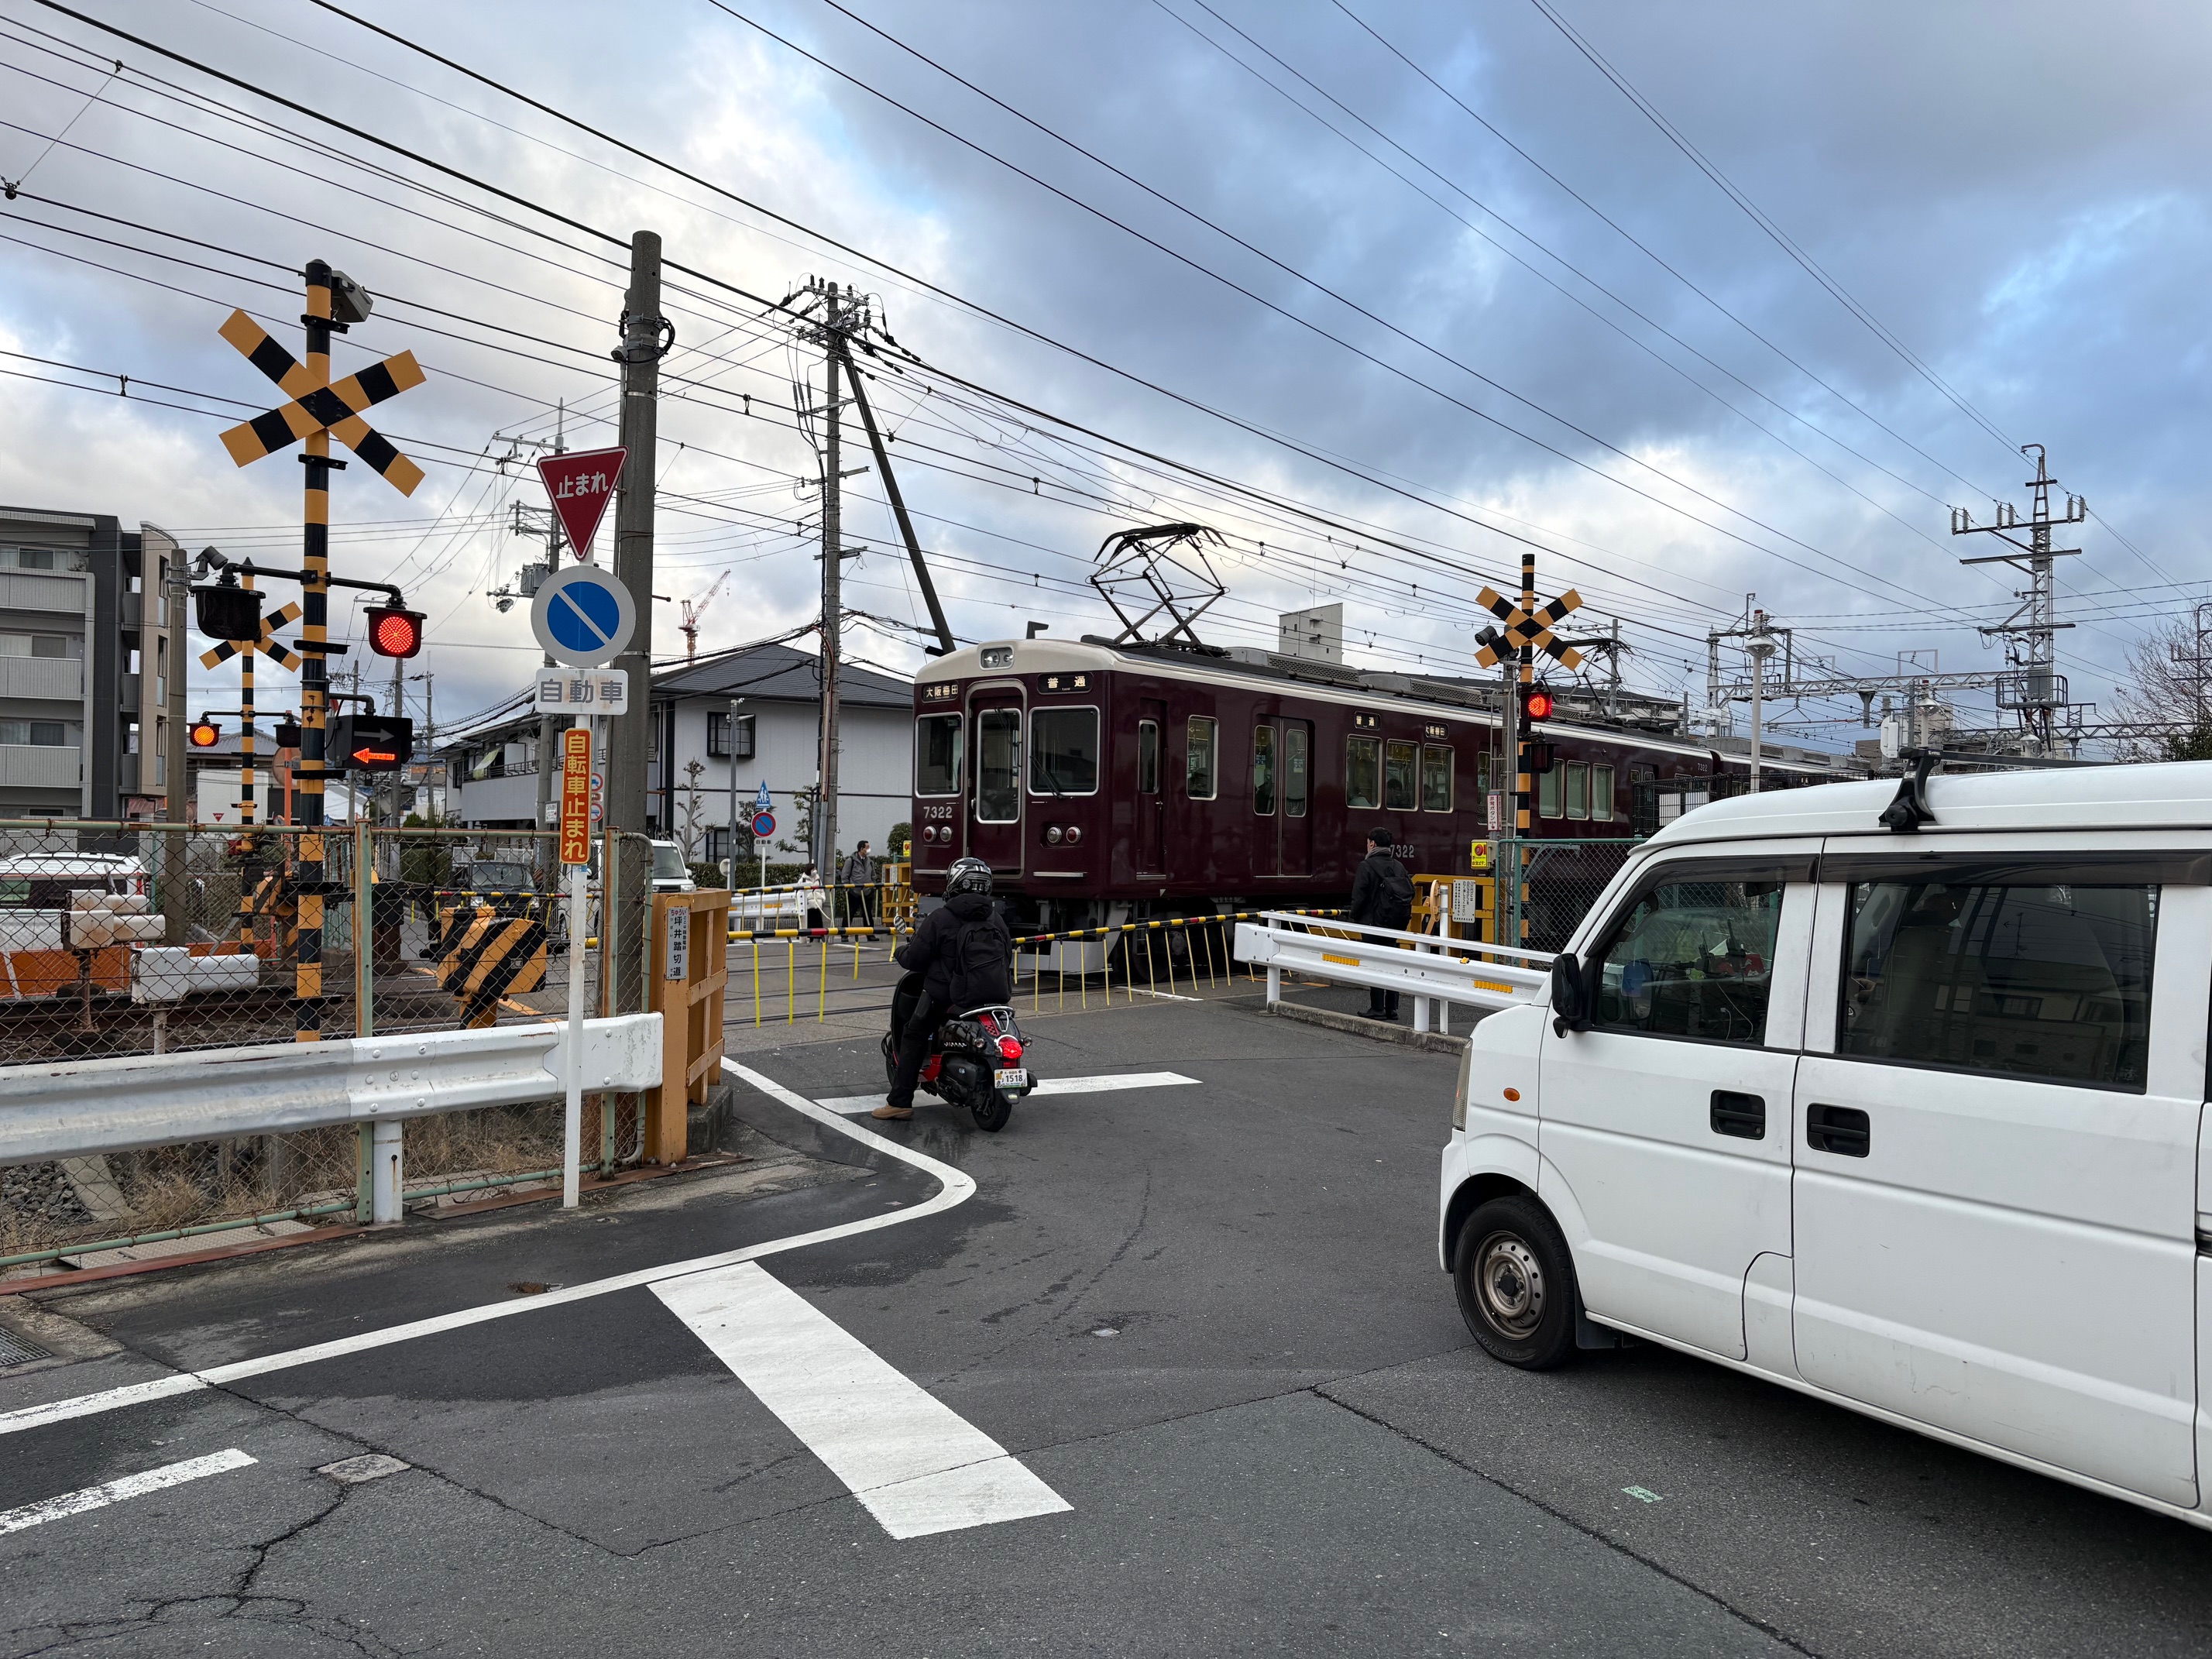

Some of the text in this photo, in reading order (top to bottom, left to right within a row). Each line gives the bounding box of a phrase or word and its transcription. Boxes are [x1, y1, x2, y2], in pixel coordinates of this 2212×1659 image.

[556, 471, 609, 499] 止まれ
[1047, 676, 1086, 689] 普通
[541, 678, 623, 704] 自動車
[926, 685, 959, 698] 大阪梅田
[564, 734, 586, 860] 自転車止まれ
[923, 806, 953, 819] 7322
[1390, 844, 1414, 858] 7322
[672, 916, 682, 977] 坪井踏切道
[1005, 1074, 1023, 1083] 1518
